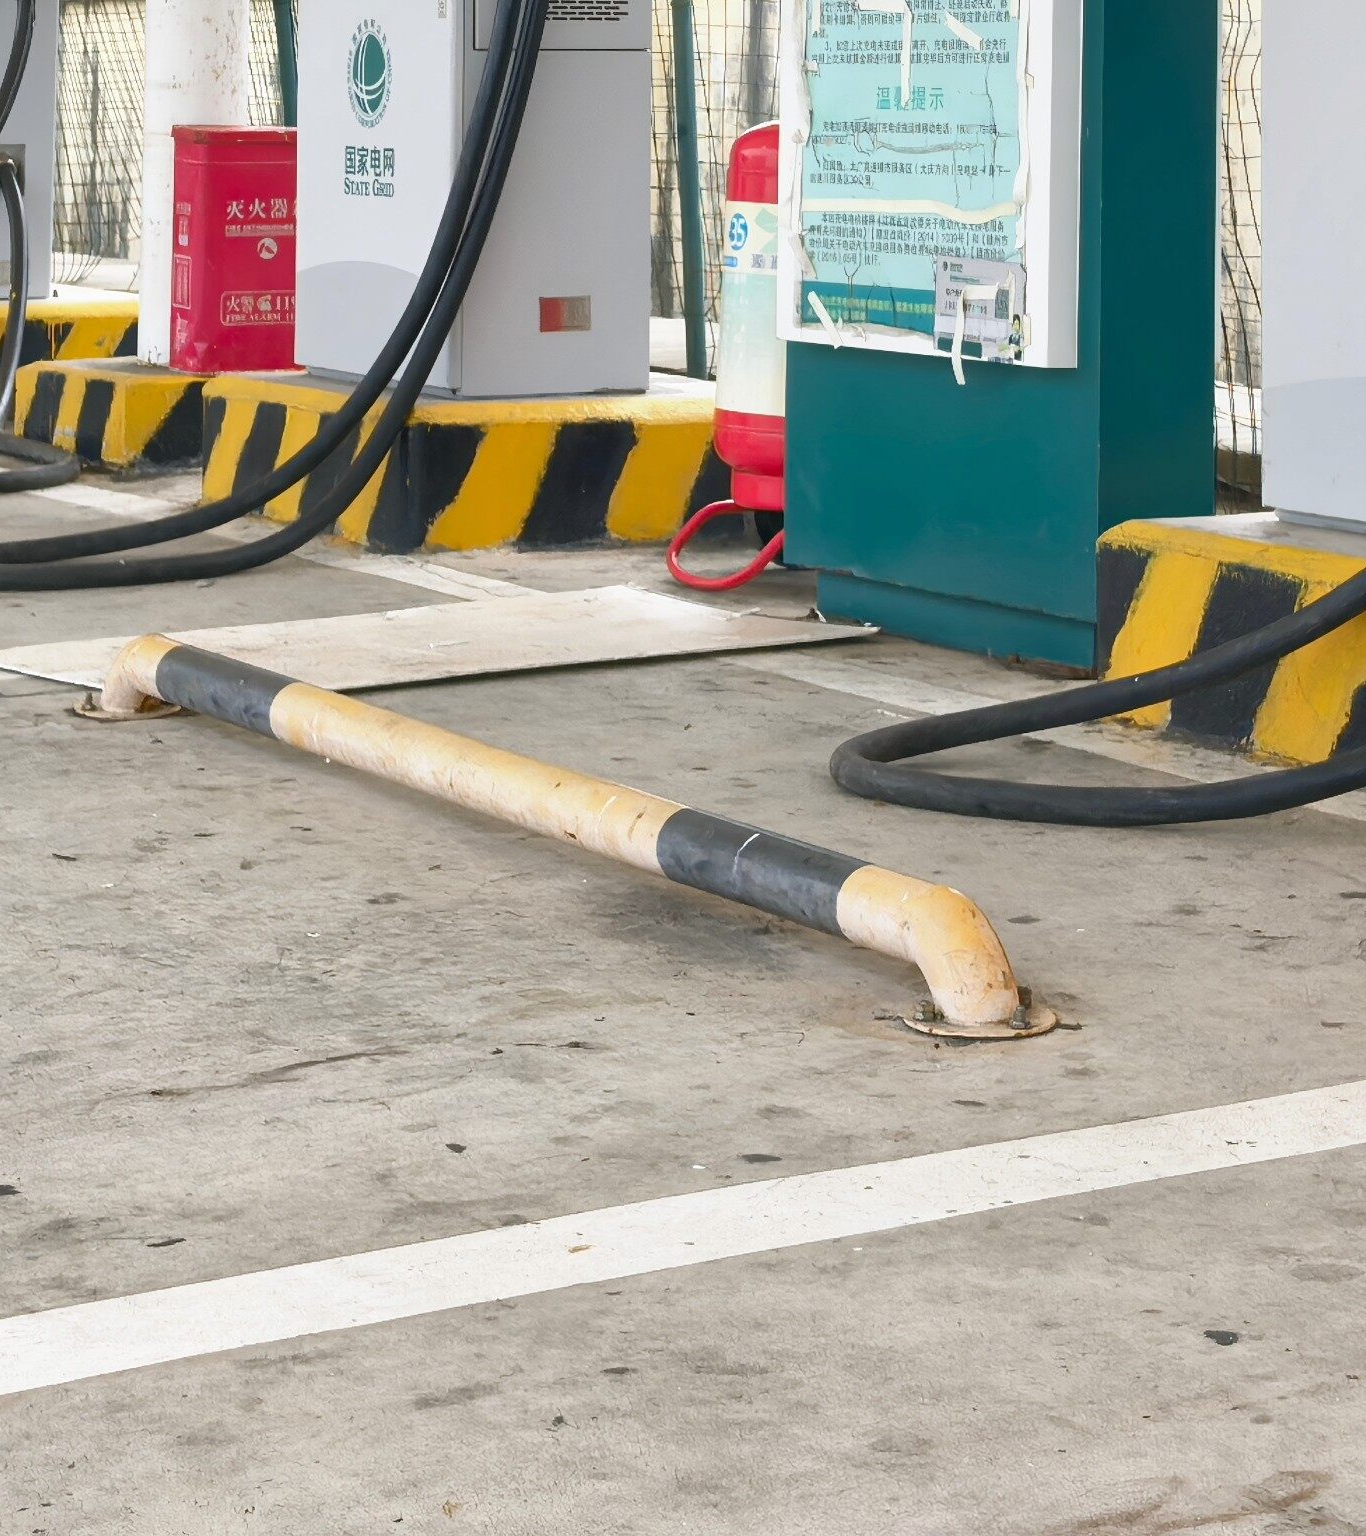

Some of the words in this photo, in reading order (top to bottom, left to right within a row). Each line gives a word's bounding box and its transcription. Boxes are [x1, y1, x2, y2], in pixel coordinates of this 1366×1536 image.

[345, 145, 395, 178] 国家电网
[226, 198, 297, 221] 灭火器
